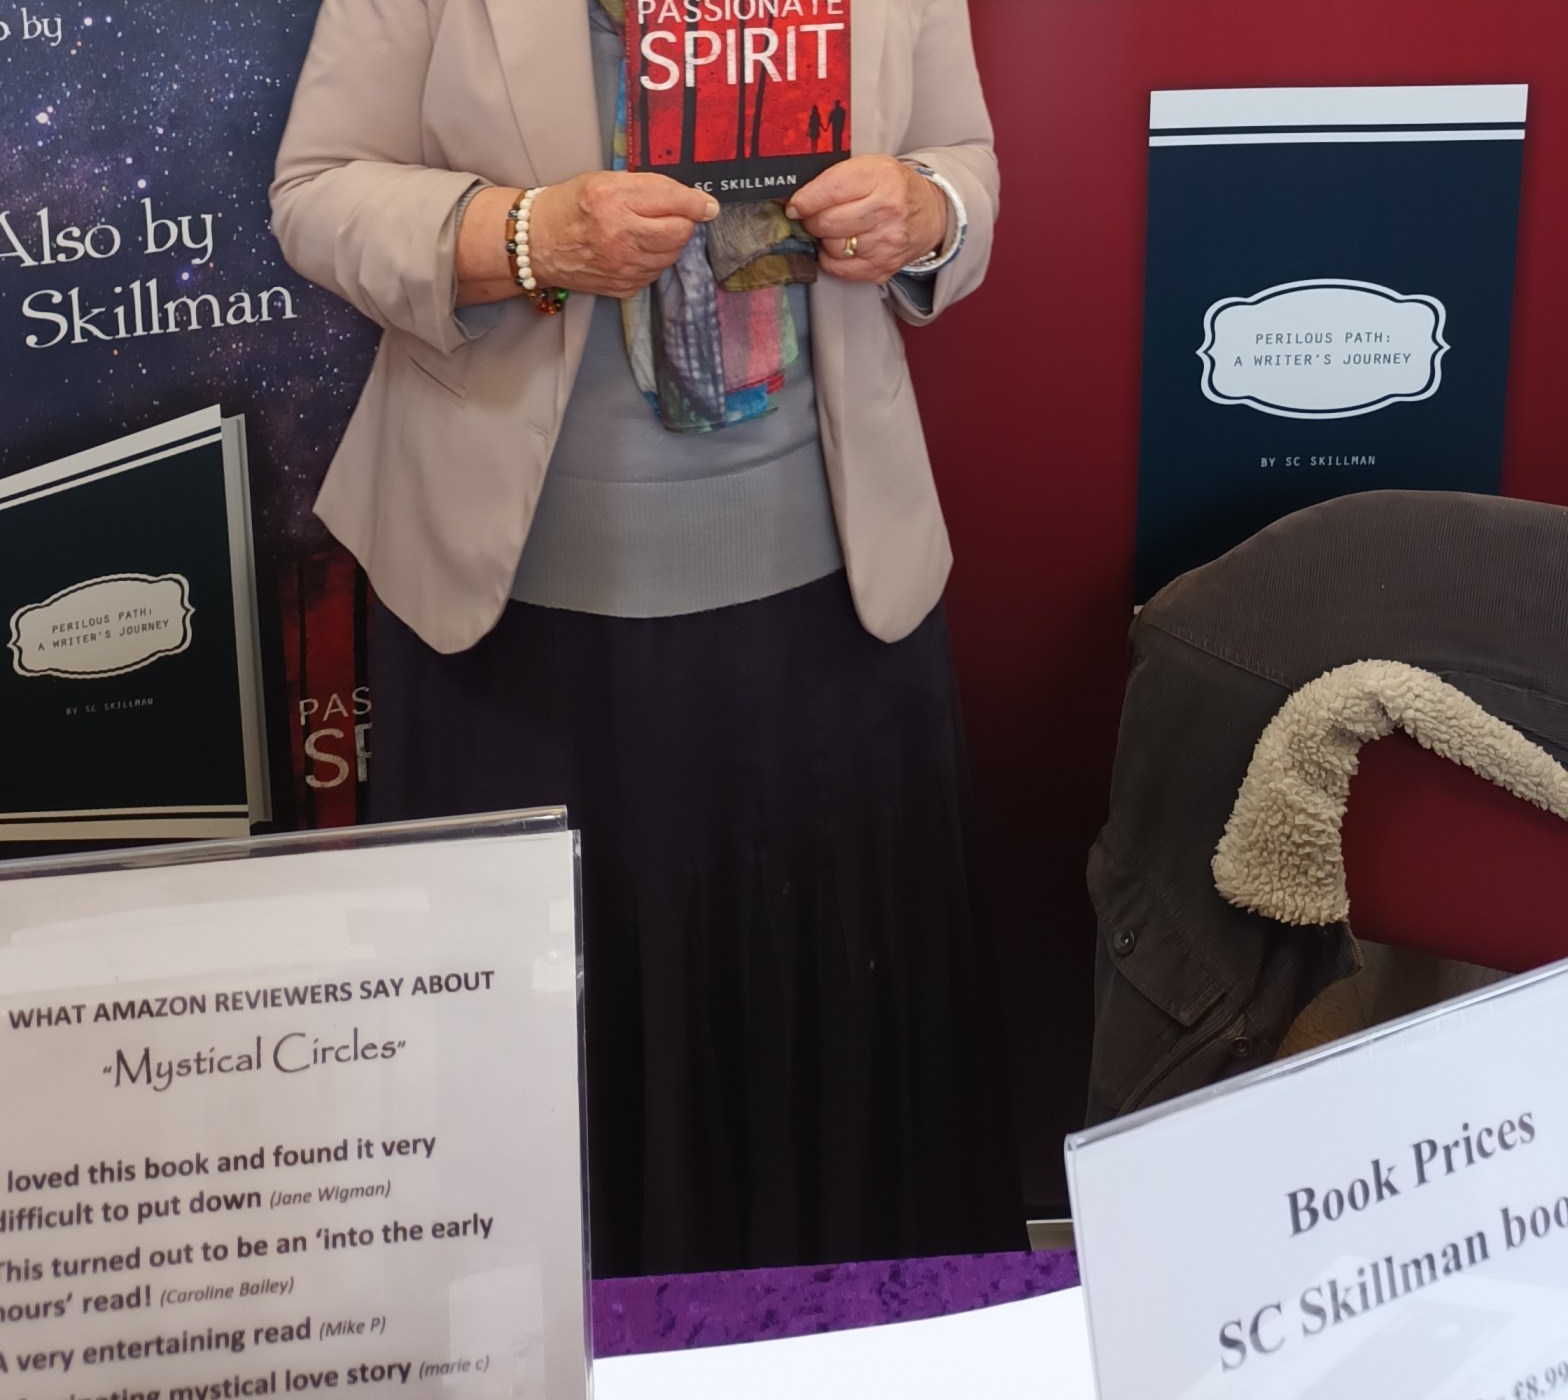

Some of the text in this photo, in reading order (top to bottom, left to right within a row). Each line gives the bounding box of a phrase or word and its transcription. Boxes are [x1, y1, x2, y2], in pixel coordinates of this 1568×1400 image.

[21, 7, 62, 47] by
[639, 22, 845, 91] SPIRIT
[720, 175, 797, 191] SKILLMAN
[140, 197, 213, 265] by
[22, 277, 298, 349] Skillman
[1255, 331, 1392, 345] PERILOUS PATH:
[1234, 353, 1412, 367] A WRITER'S JOURNEY
[1260, 456, 1376, 468] BY SC SKILLMAN
[38, 619, 169, 651] A WRITER'S JOURNEY
[52, 607, 152, 634] PERILOUS PATH:
[104, 698, 154, 711] SKILLMAN
[299, 686, 372, 726] PAS
[8, 970, 495, 1030] WHAT AMAZON REVIEWERS SAY ABOUT
[7, 1136, 436, 1193] loved this book and found it very
[1286, 1111, 1536, 1238] Book Prices
[101, 1202, 129, 1223] to
[137, 1196, 181, 1224] put
[189, 1190, 262, 1214] down
[269, 1188, 312, 1210] (Jane
[318, 1179, 391, 1204] Wigman)
[52, 1246, 141, 1278] turned
[149, 1243, 194, 1268] out
[201, 1241, 228, 1261] to
[237, 1236, 268, 1258] be
[276, 1235, 307, 1254] an
[382, 1220, 423, 1244] the
[431, 1213, 493, 1239] early
[82, 1285, 152, 1314] read!
[160, 1284, 234, 1308] (Caroline
[239, 1276, 294, 1298] Bailey)
[1218, 1302, 1285, 1373] SC
[1298, 1230, 1490, 1338] Skillman
[17, 1349, 75, 1372] very
[82, 1328, 245, 1365] entertaining
[253, 1316, 311, 1344] read
[319, 1319, 365, 1341] (Mike
[370, 1315, 386, 1335] P)
[169, 1371, 277, 1400] mystical
[285, 1369, 338, 1393] love
[347, 1362, 412, 1385] story
[419, 1361, 470, 1380] (marie
